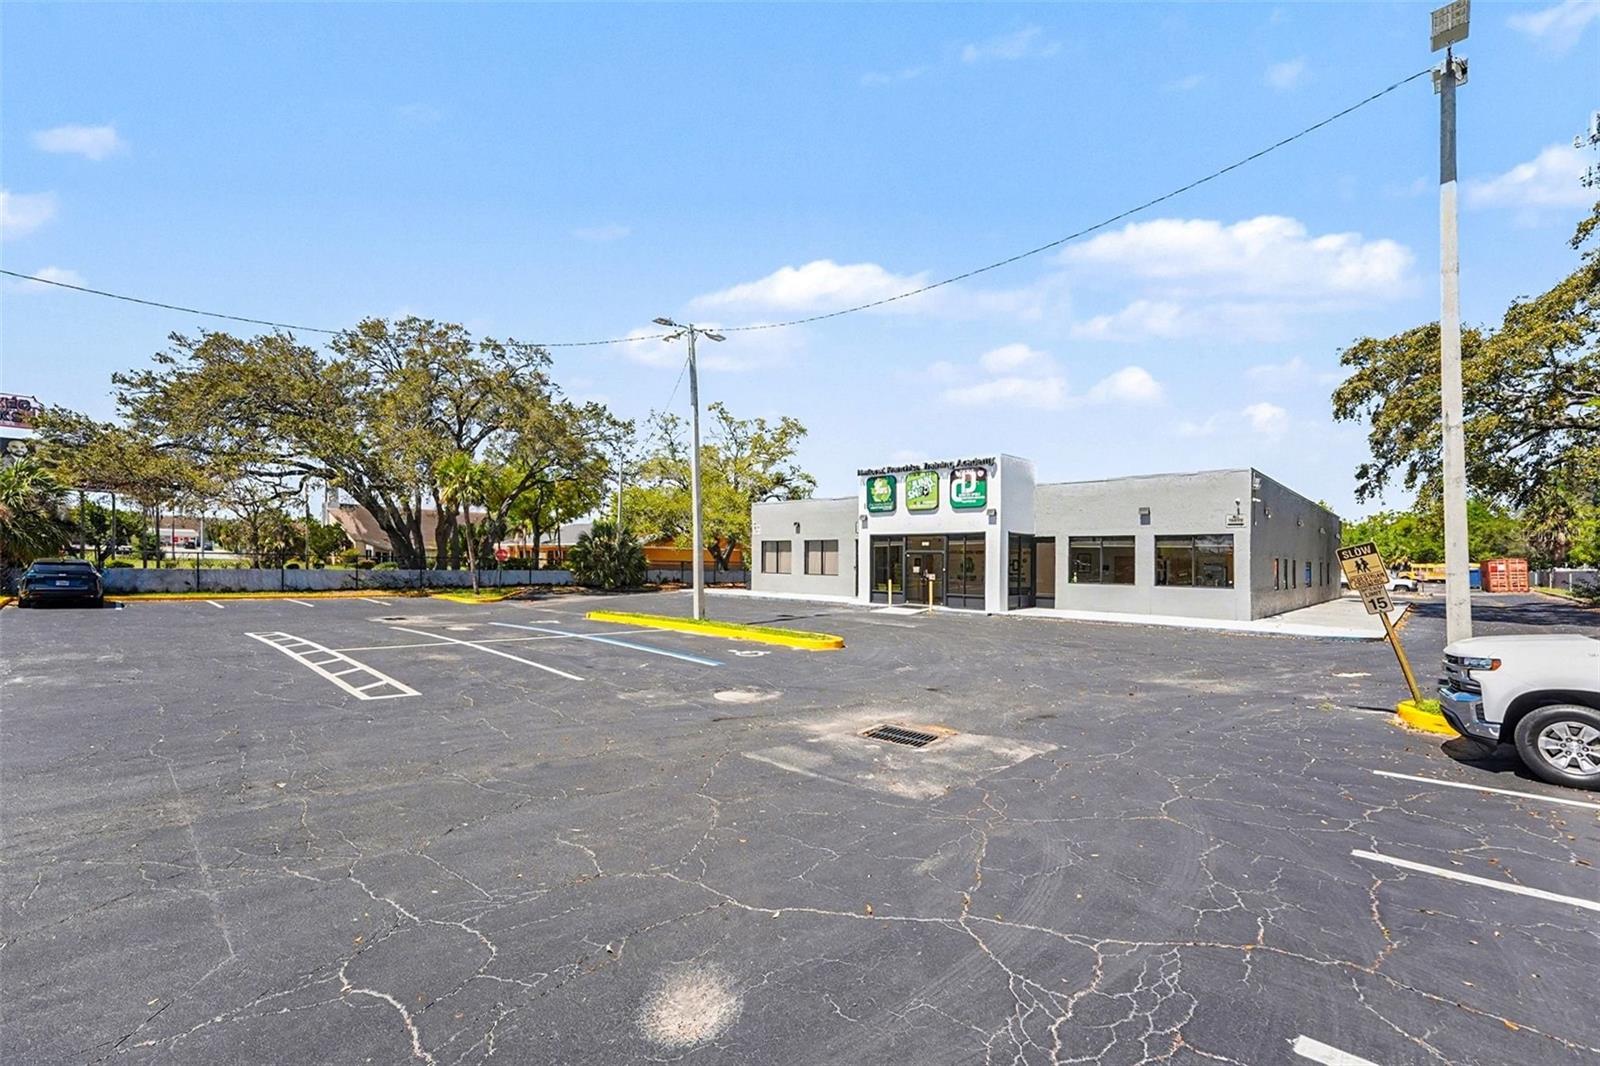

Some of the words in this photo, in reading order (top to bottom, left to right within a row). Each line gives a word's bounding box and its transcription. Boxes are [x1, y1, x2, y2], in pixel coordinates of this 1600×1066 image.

[956, 457, 996, 467] Academy
[1342, 545, 1371, 559] SLOW
[1368, 597, 1388, 610] 15
